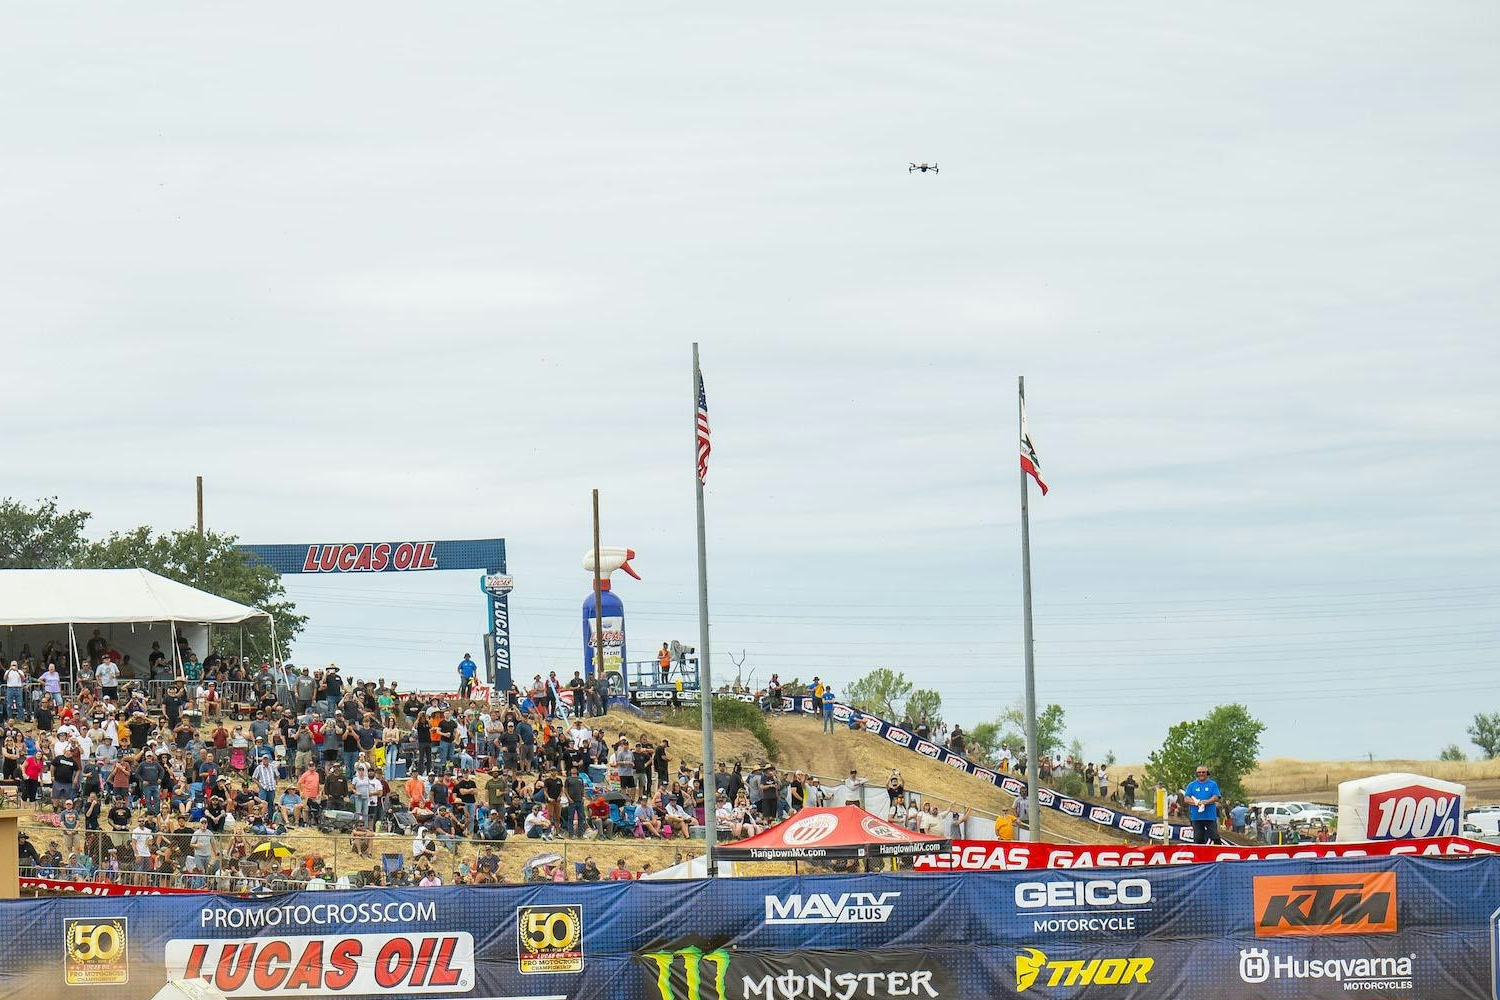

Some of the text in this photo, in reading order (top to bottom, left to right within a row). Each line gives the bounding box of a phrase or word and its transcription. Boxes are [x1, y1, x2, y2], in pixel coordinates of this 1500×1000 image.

[302, 541, 437, 572] LUCAS OIL
[494, 601, 509, 669] LUCAS OIL
[636, 690, 673, 700] GEICO
[889, 729, 908, 743] 100%
[918, 742, 937, 756] 100%
[1061, 800, 1081, 812] 100%
[1092, 809, 1111, 821] 100%
[1375, 796, 1456, 838] 100%
[1121, 817, 1141, 831] 100%
[750, 847, 827, 858] HangtownMX.com
[880, 843, 941, 855] HangtownMX.com
[913, 844, 1029, 871] ASGAS
[765, 892, 901, 921] MAVTV
[1015, 878, 1152, 908] GEICO
[1259, 883, 1391, 927] KTM
[200, 902, 437, 929] PROMOTOCROSS.COM
[848, 908, 882, 921] PLUS
[1034, 917, 1135, 933] MOTORCYCLE
[74, 925, 120, 961] 50
[528, 912, 575, 949] 50
[184, 936, 463, 992] LUCAS OIL
[1046, 957, 1155, 987] THOR
[1274, 953, 1413, 981] Husqvarna
[1343, 981, 1413, 990] MOTORCYCLES
